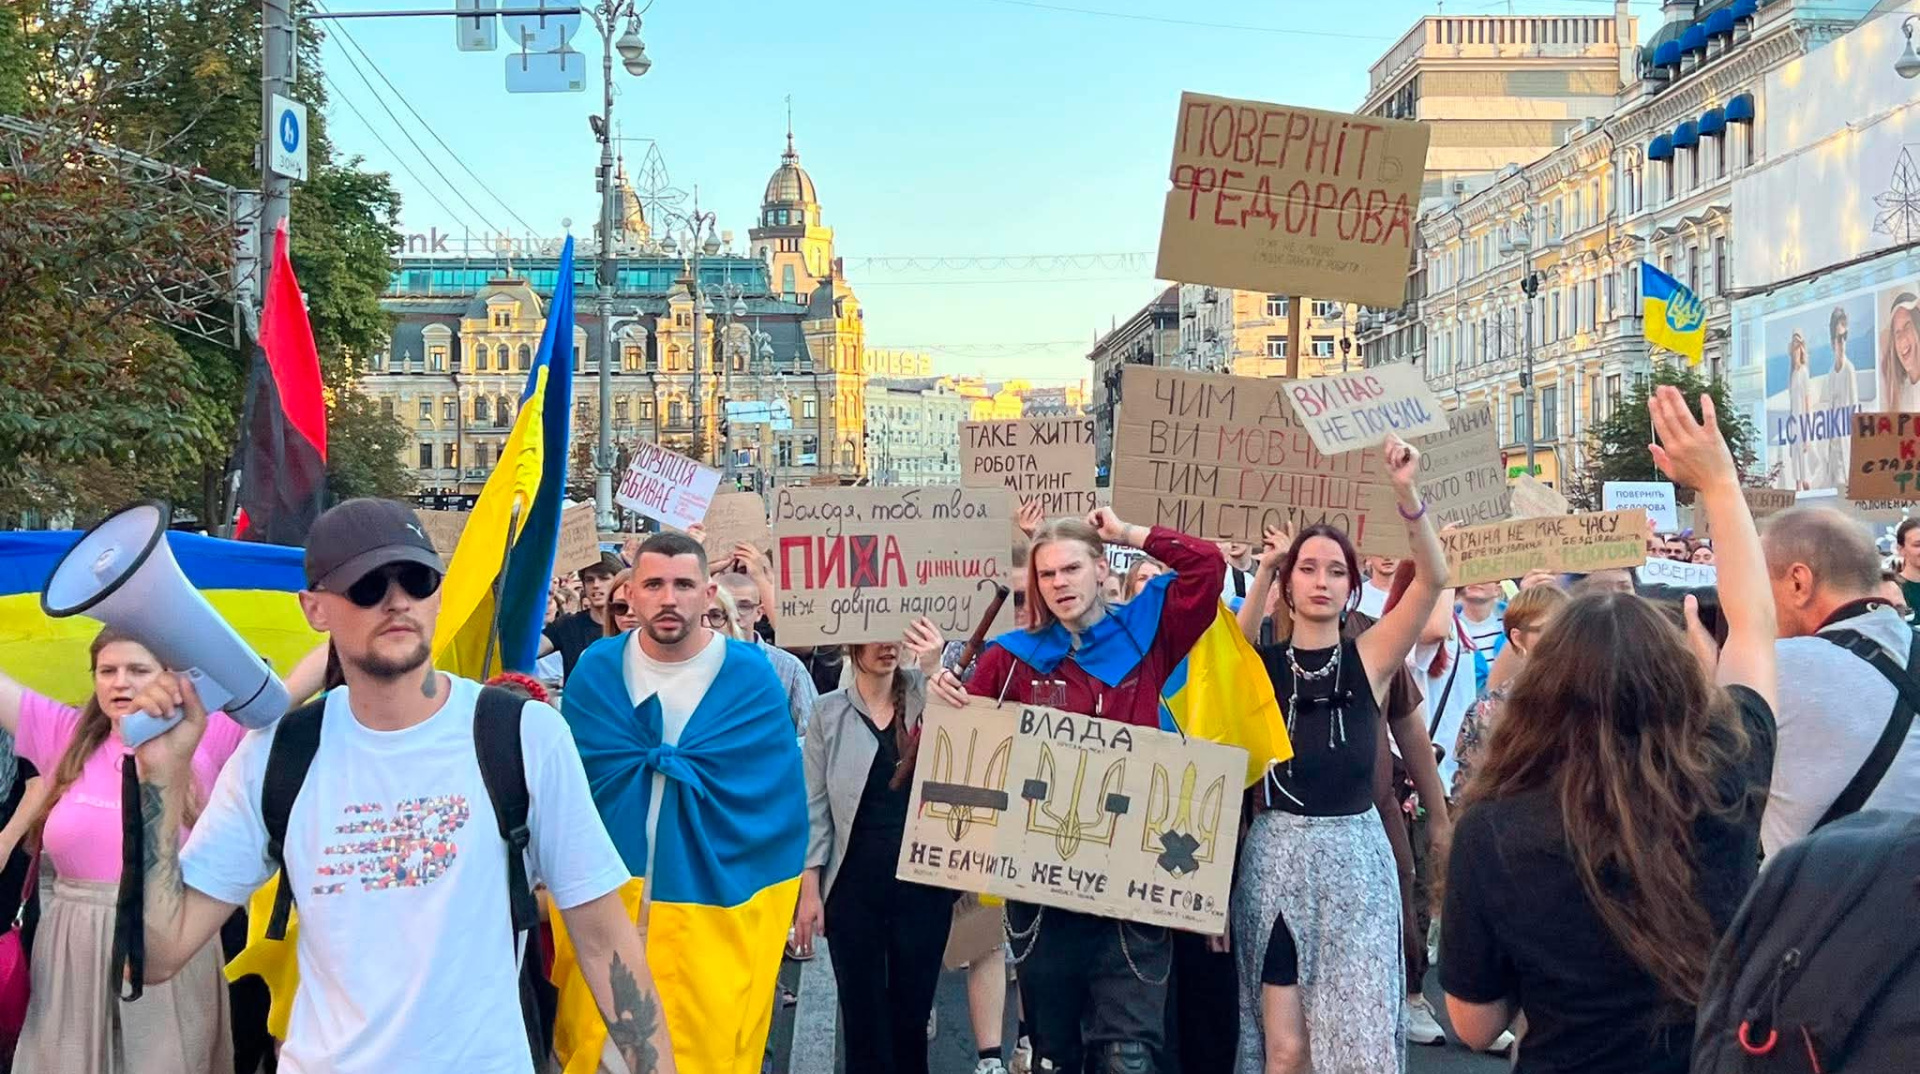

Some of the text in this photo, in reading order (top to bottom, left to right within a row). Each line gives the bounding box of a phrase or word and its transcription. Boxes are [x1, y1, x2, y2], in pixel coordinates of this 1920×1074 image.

[1174, 164, 1410, 248] ФЕДОРОВА
[1155, 378, 1235, 421] ЧИМ
[1292, 376, 1384, 416] ВИ НАС
[966, 420, 1095, 448] ТАКЕ ЖИТТЯ
[1149, 419, 1200, 458] ВИ
[1317, 396, 1431, 447] НЕ ПОЧУЛИ
[1778, 414, 1797, 445] LC
[632, 441, 697, 487] КОРУПЦІЯ
[974, 454, 1037, 474] РОБОТА
[1004, 472, 1072, 491] МІТИНГ
[620, 468, 676, 513] ВБИВАЄ
[872, 488, 922, 519] тобі
[932, 488, 987, 519] твоя
[1149, 460, 1373, 511] ТИМ ГУЧНІШЕ
[1421, 476, 1460, 504] ЯКОГО
[1465, 466, 1499, 492] ФІГА
[1615, 490, 1664, 498] ПОВЕРНІТЬ
[1157, 498, 1204, 538] МИ
[1508, 523, 1525, 541] НЕ
[1535, 519, 1566, 538] МАЄ
[1580, 515, 1619, 535] ЧАСУ
[779, 534, 908, 590] ПИХА
[782, 596, 814, 617] ніж
[821, 586, 890, 634] довіра
[1020, 709, 1132, 752] ВЛАДА
[909, 841, 942, 867] НЕ
[948, 849, 1017, 879] БАЧИТЬ
[1032, 862, 1062, 886] НЕ
[1127, 879, 1165, 903] НЕ
